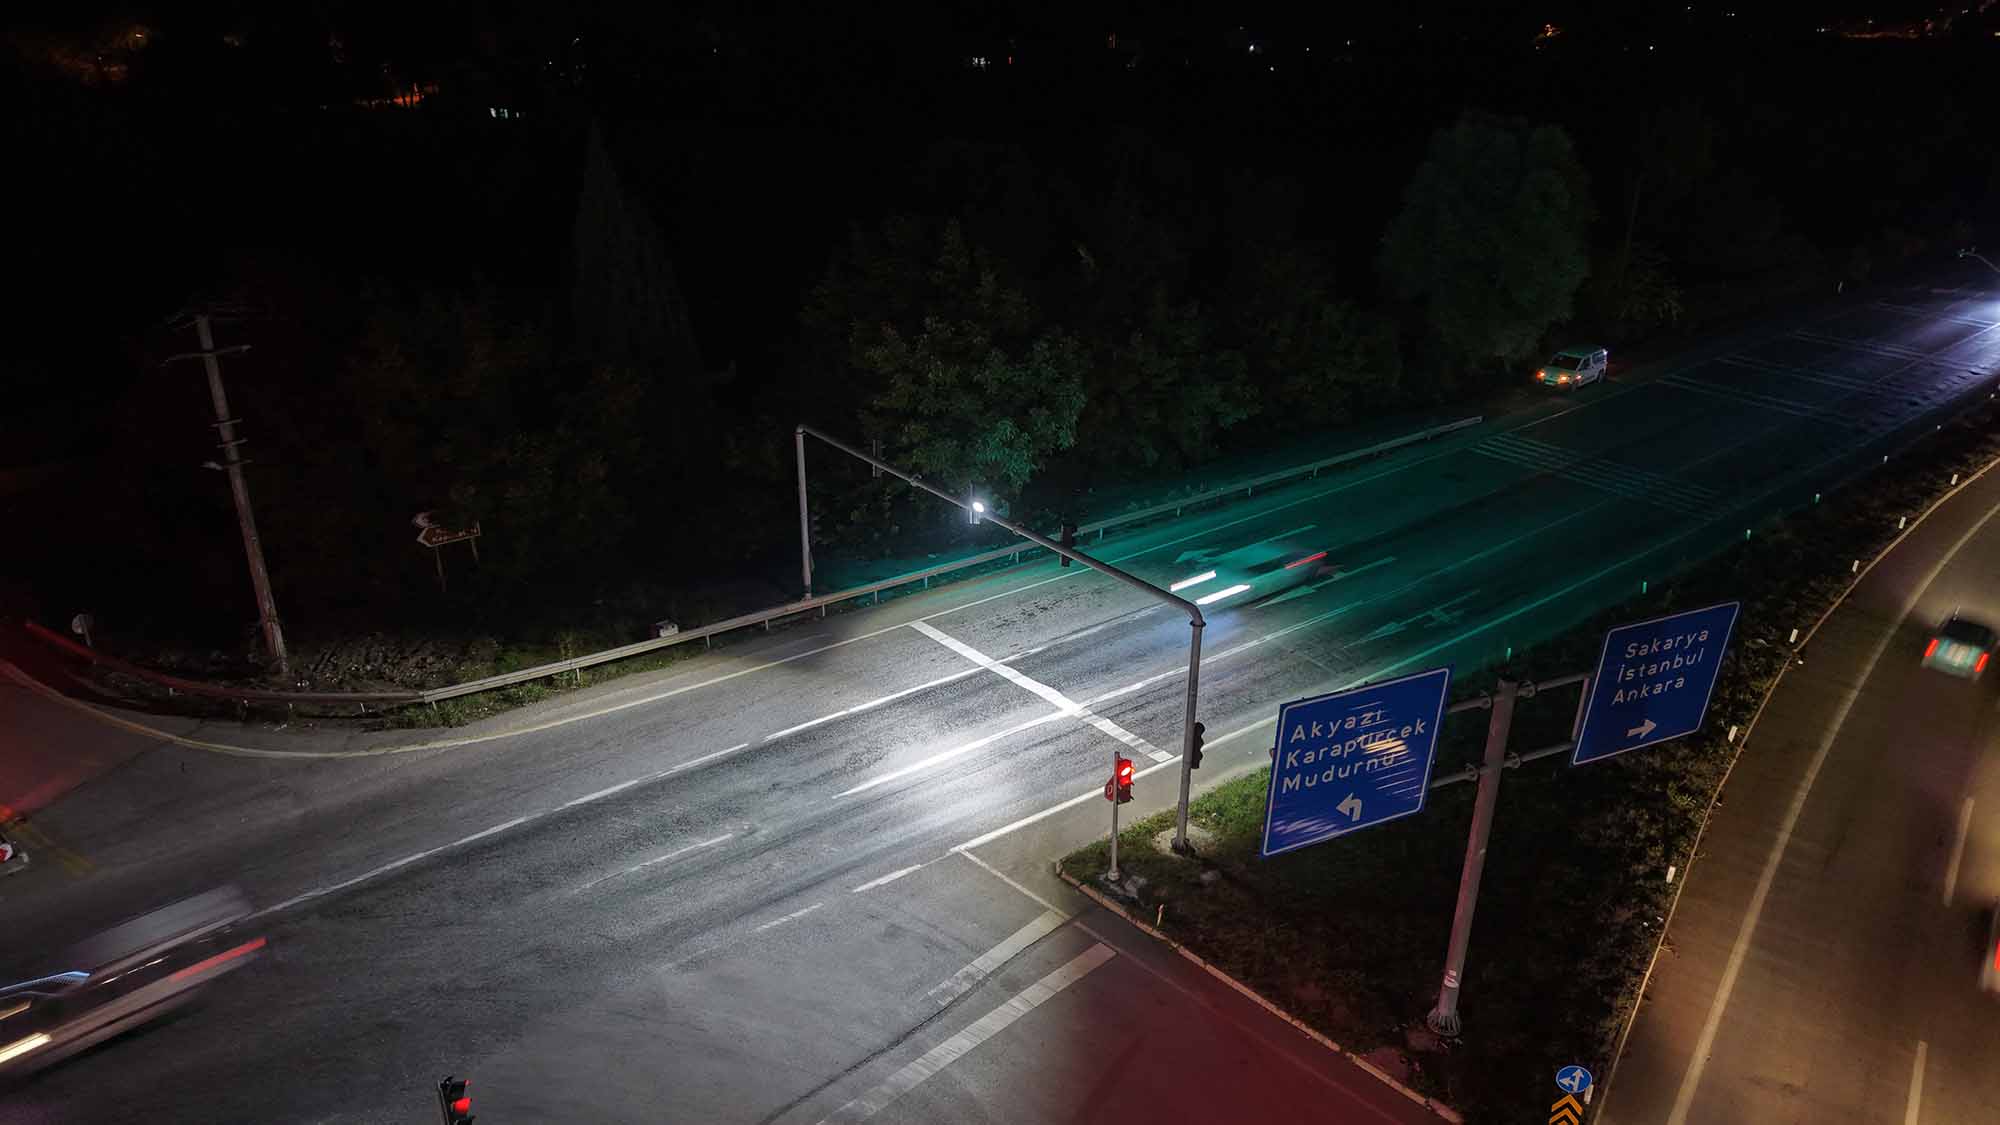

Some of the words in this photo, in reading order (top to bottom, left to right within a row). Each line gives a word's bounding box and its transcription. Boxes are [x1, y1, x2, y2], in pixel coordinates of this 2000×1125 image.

[1625, 629, 1709, 658] Sakarya
[1617, 648, 1704, 683] İstanbul
[1611, 677, 1685, 706] Ankara
